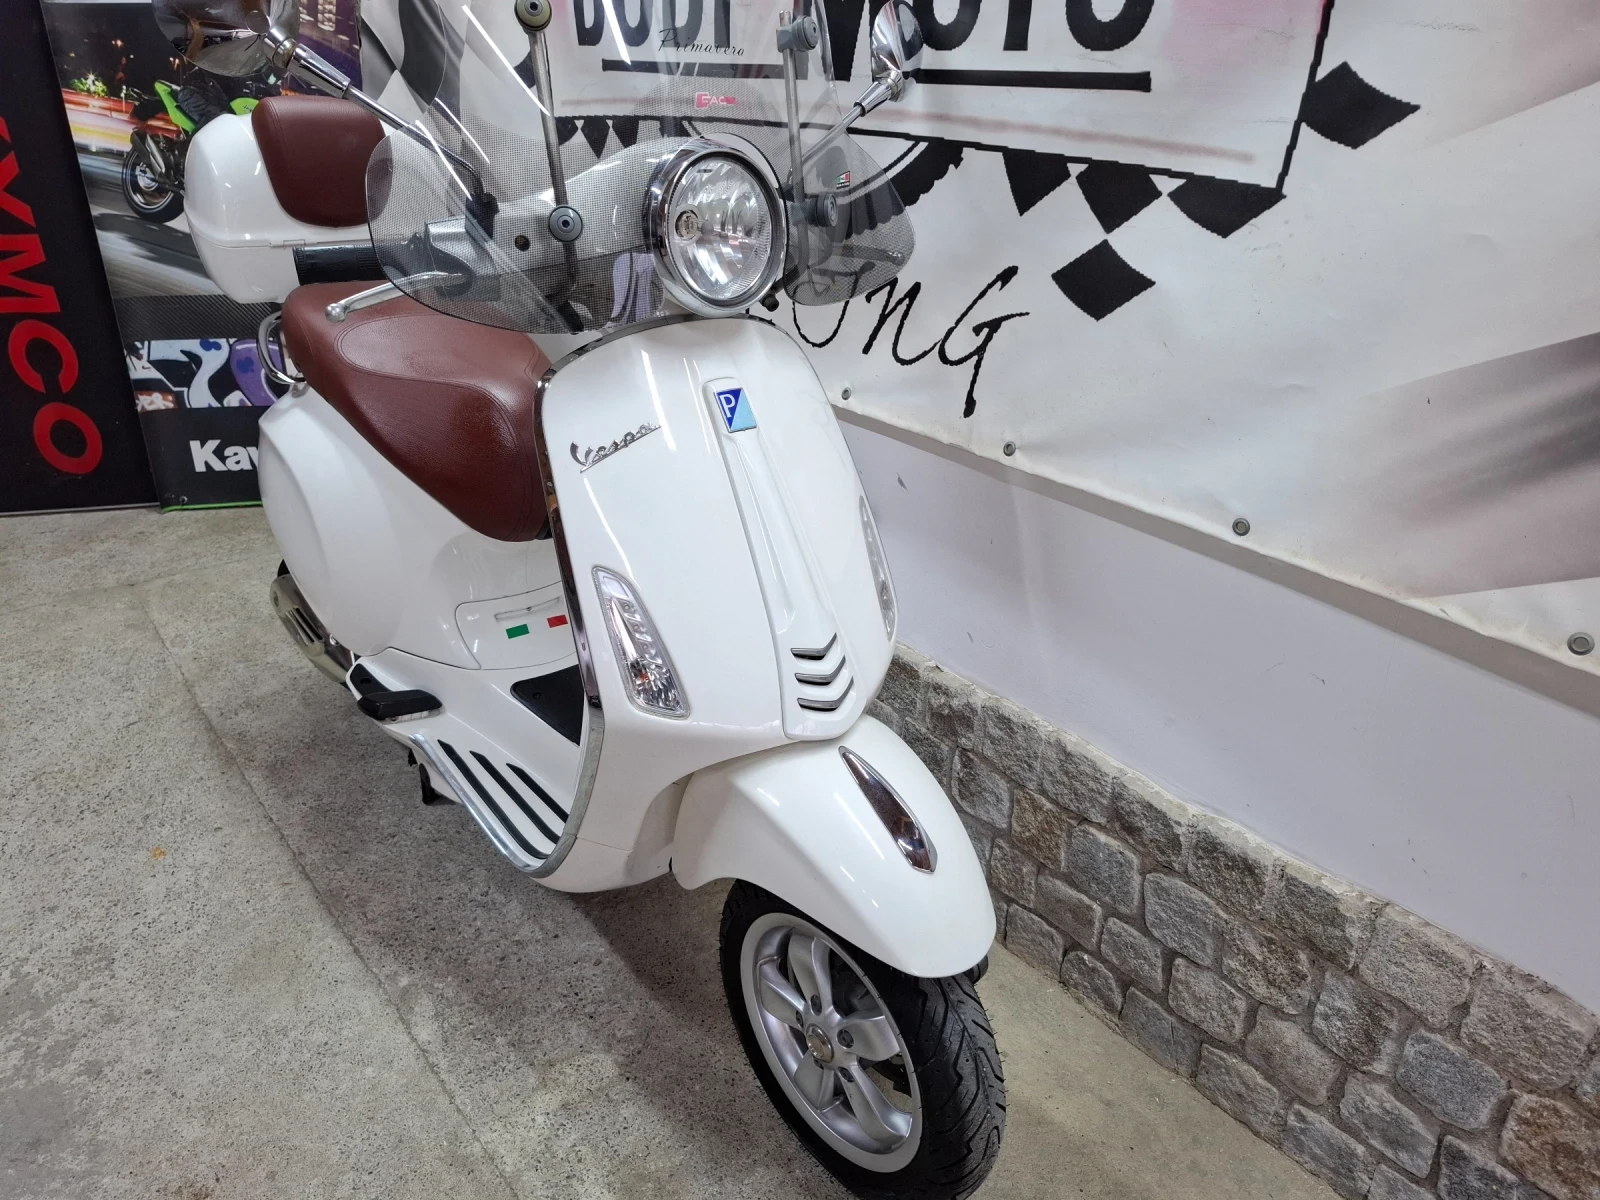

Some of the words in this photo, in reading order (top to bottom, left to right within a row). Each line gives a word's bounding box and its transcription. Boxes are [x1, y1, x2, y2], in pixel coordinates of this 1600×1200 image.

[658, 27, 746, 56] Primavera
[0, 116, 103, 475] YMCO
[569, 420, 663, 475] Vespa
